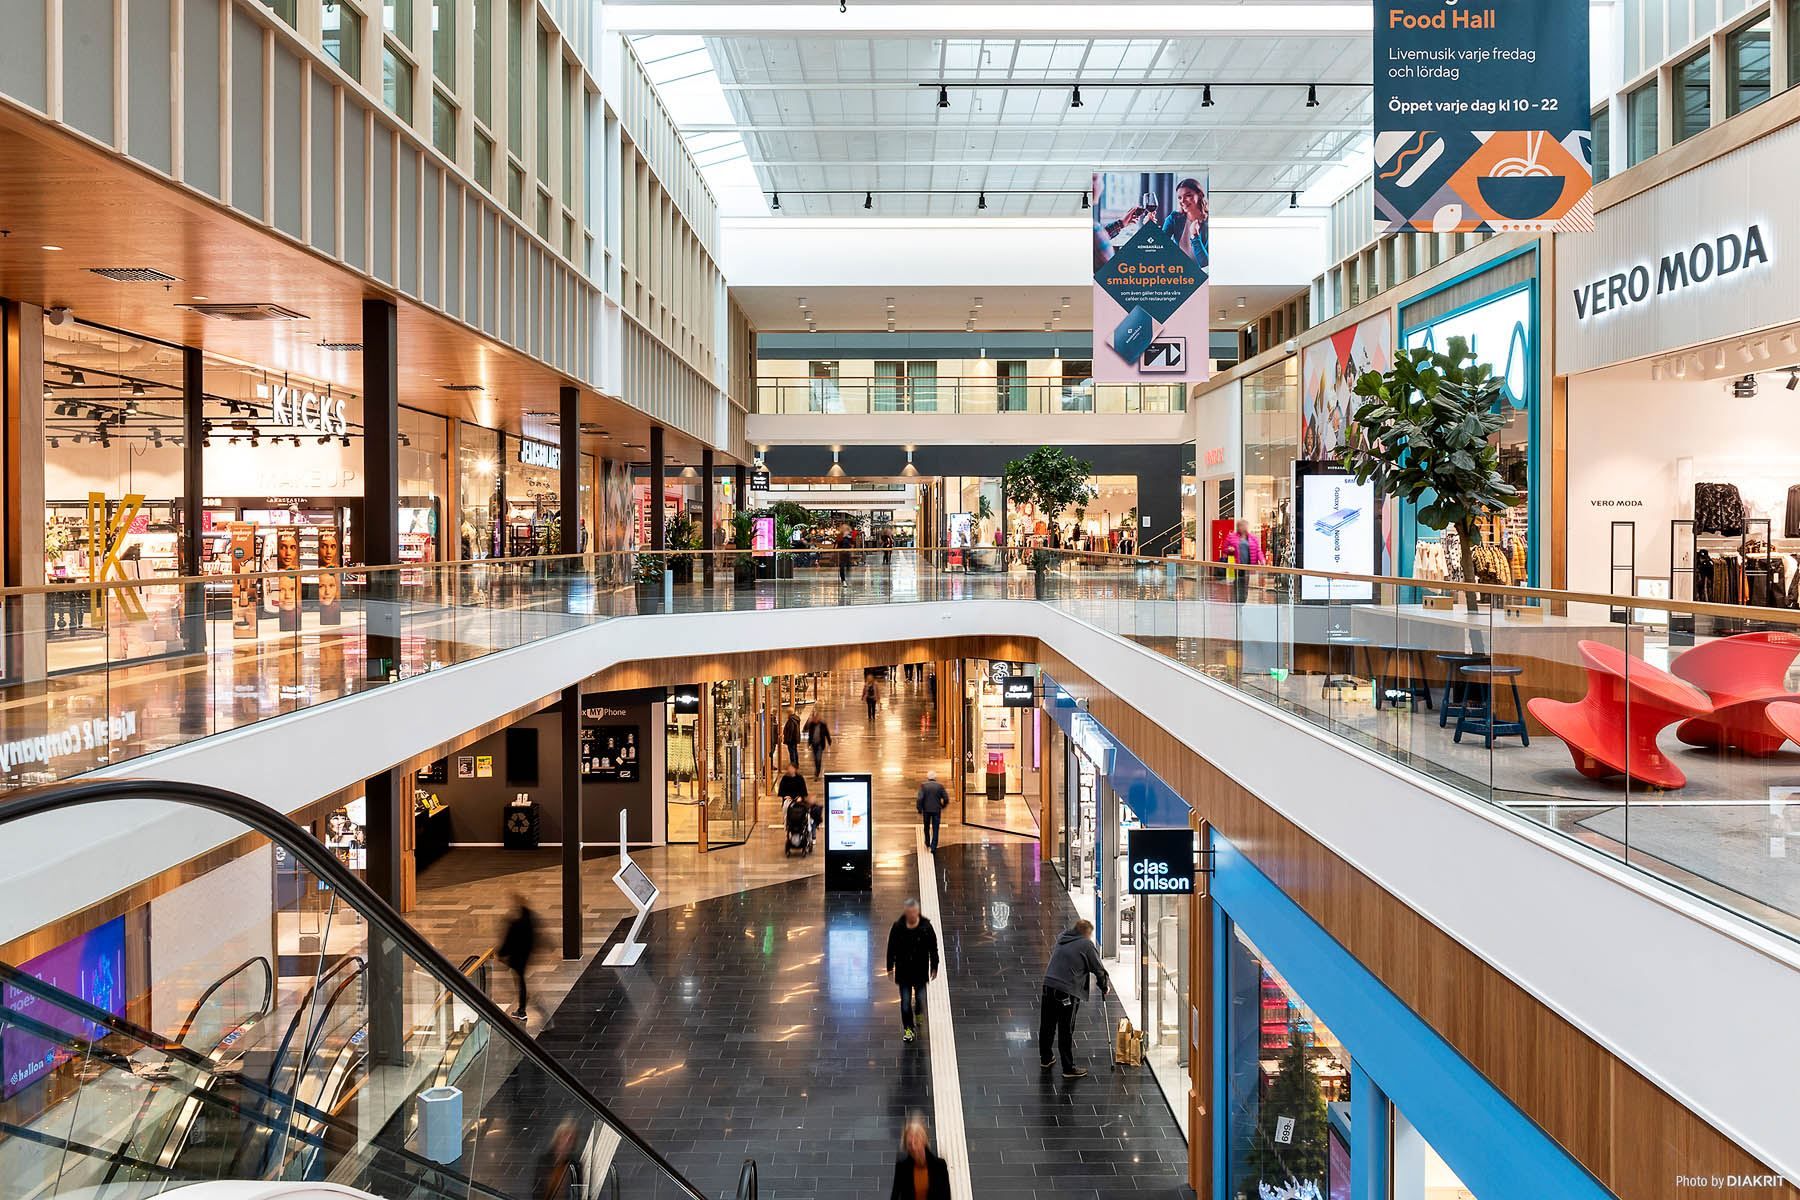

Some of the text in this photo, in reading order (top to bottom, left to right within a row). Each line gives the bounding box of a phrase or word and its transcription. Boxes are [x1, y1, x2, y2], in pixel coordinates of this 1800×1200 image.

[1389, 9, 1495, 29] Food Hall
[1388, 48, 1536, 63] Livemusik varje fredag
[1388, 65, 1459, 80] och lördag
[1388, 96, 1433, 114] Öppet
[1435, 99, 1468, 114] varje
[1471, 99, 1496, 114] dag
[1499, 99, 1510, 111] kl
[1513, 99, 1529, 111] 10
[1541, 98, 1558, 111] 22
[1117, 263, 1184, 274] Ge bort en
[1573, 224, 1769, 320] VERO MODA
[1106, 276, 1195, 287] smakupplevelse
[272, 384, 347, 435] KICKS
[590, 708, 601, 716] MY
[604, 708, 627, 716] Phone
[1133, 858, 1169, 875] clas
[1133, 874, 1190, 890] ohlson
[18, 1060, 44, 1083] hallon
